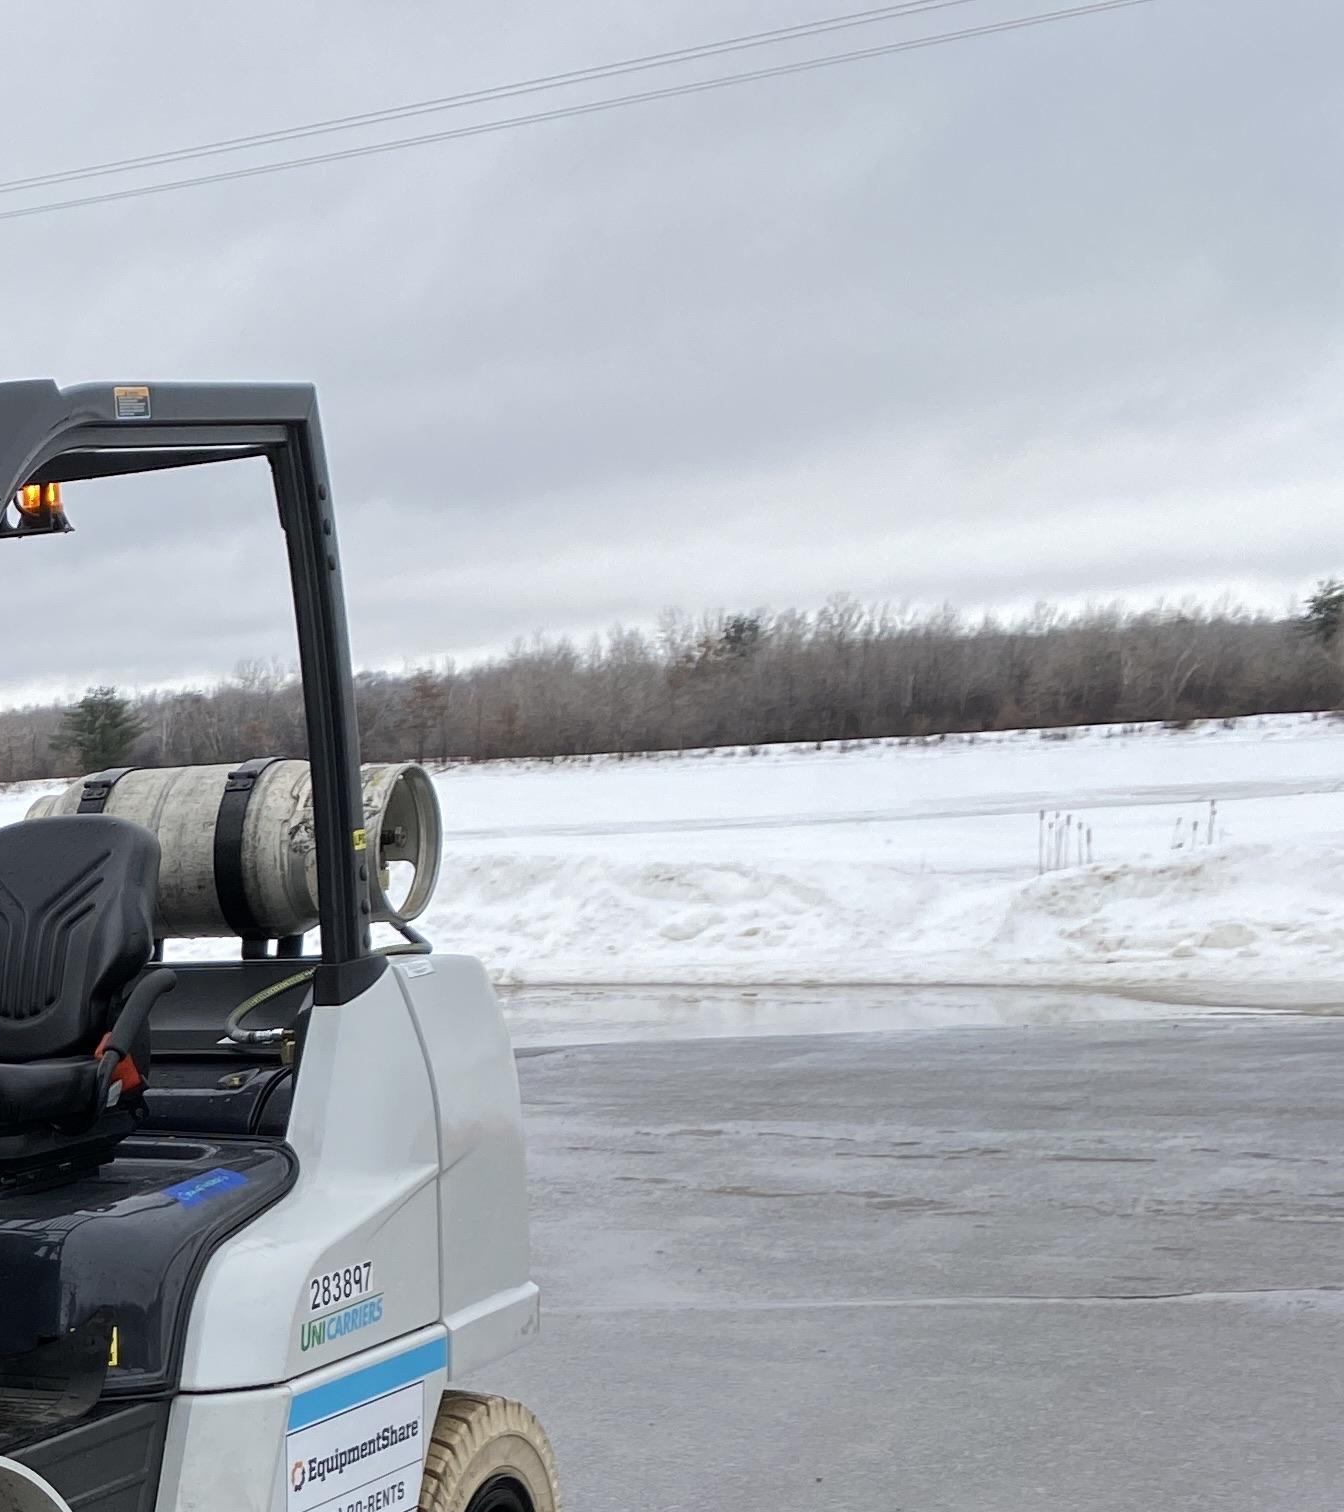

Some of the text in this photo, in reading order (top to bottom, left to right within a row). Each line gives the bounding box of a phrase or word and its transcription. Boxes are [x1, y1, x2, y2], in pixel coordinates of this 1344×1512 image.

[311, 1261, 372, 1311] 283897
[301, 1297, 384, 1352] UNICARRIERS
[307, 1420, 419, 1482] EquipmentShare
